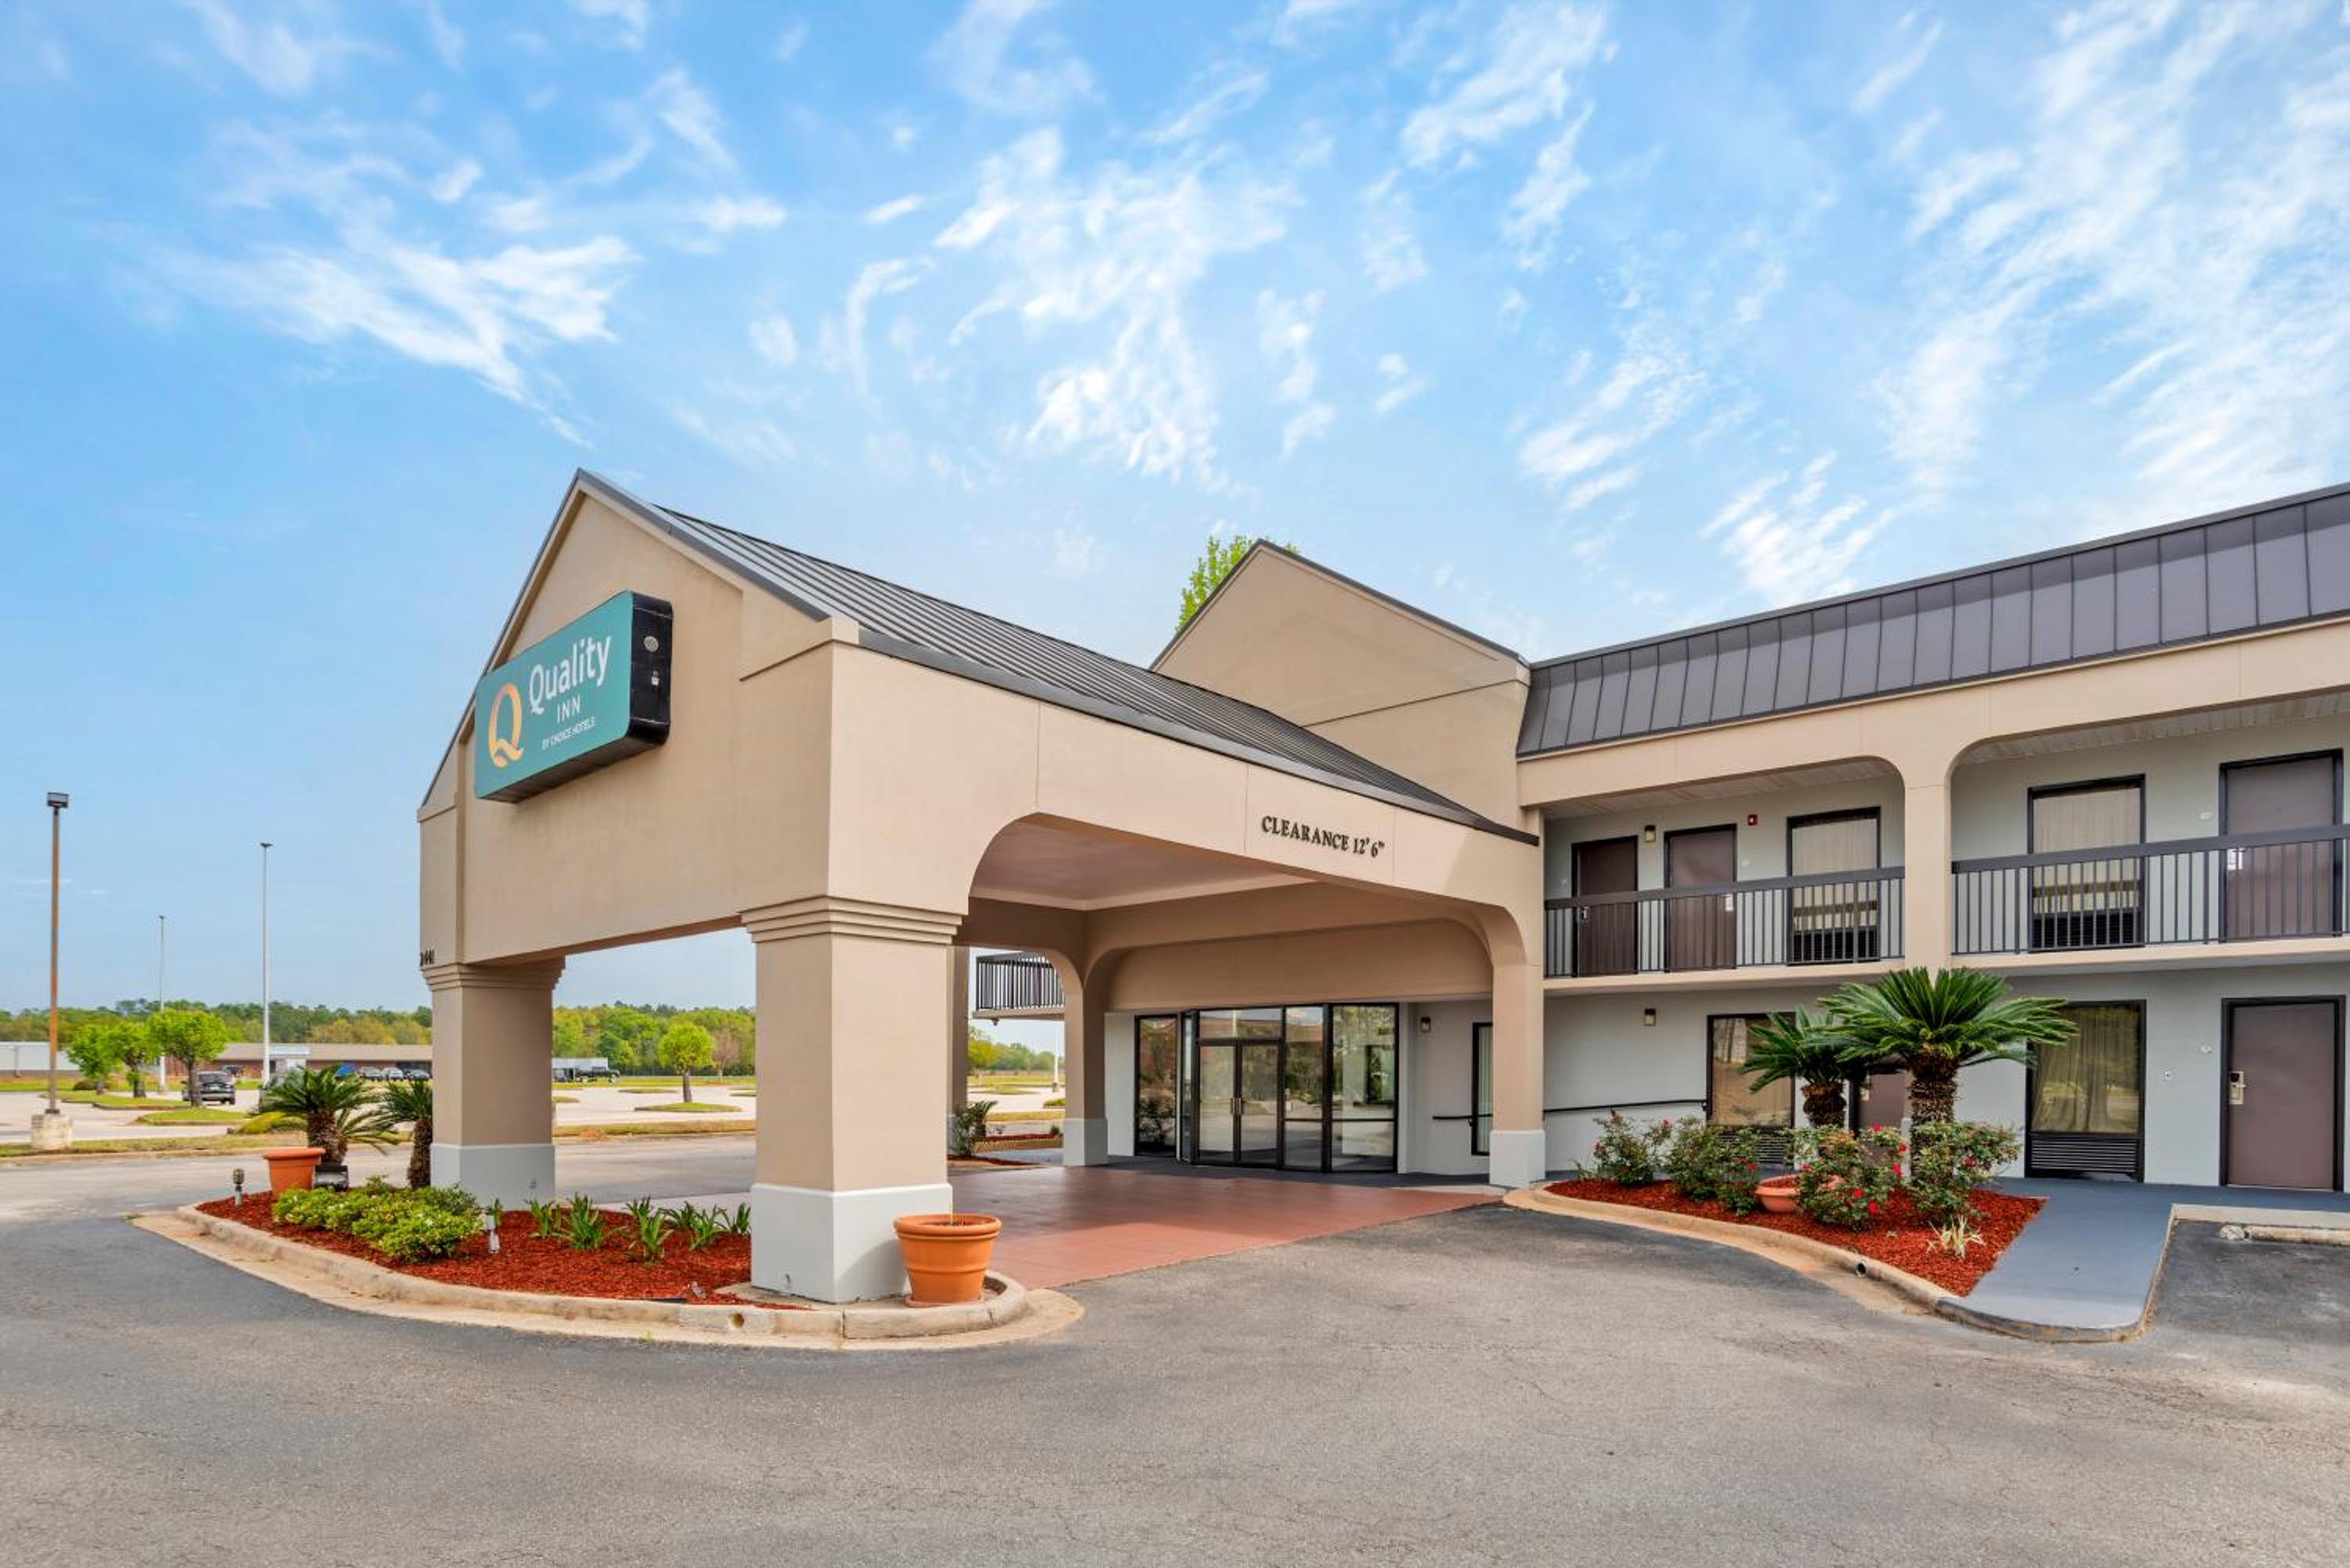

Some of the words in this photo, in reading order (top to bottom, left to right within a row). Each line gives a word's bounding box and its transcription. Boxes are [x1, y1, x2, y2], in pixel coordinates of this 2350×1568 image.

[529, 635, 612, 715] Quality
[488, 682, 524, 768] Q
[556, 694, 581, 724] INN
[1261, 815, 1350, 851] CLEARANCE
